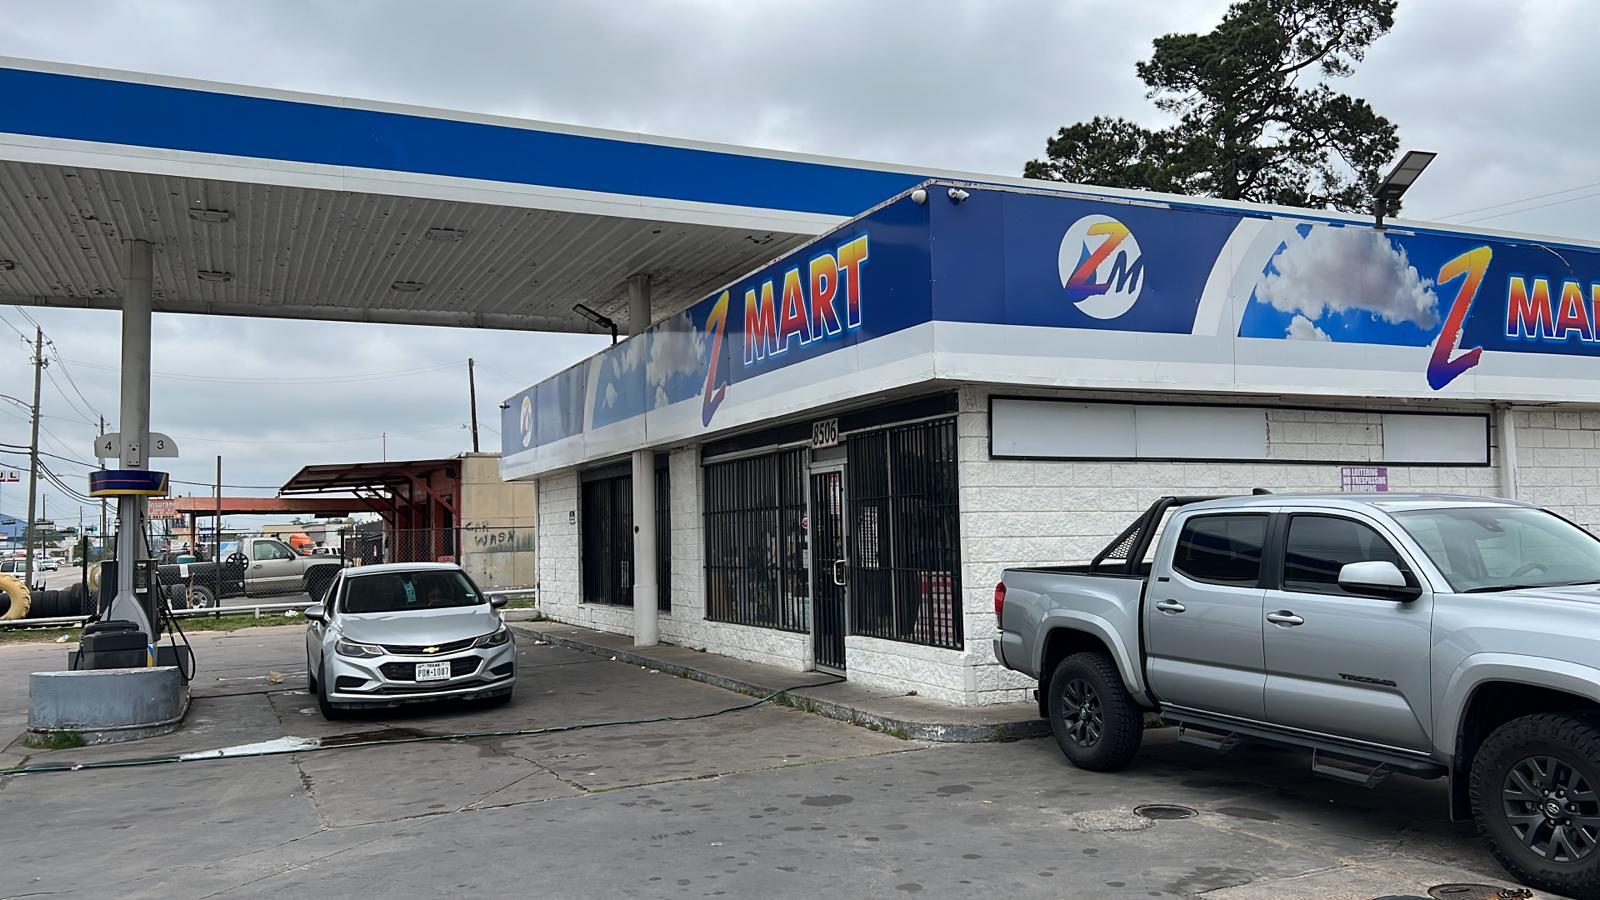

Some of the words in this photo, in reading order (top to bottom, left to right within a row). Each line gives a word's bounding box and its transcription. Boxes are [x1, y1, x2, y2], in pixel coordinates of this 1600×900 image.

[1427, 246, 1492, 390] Z
[702, 290, 729, 427] Z
[744, 235, 868, 365] MART
[813, 420, 836, 446] 8506
[105, 442, 112, 451] 4
[157, 440, 164, 450] 3
[1343, 468, 1351, 476] NO
[1351, 468, 1378, 476] LOITERING
